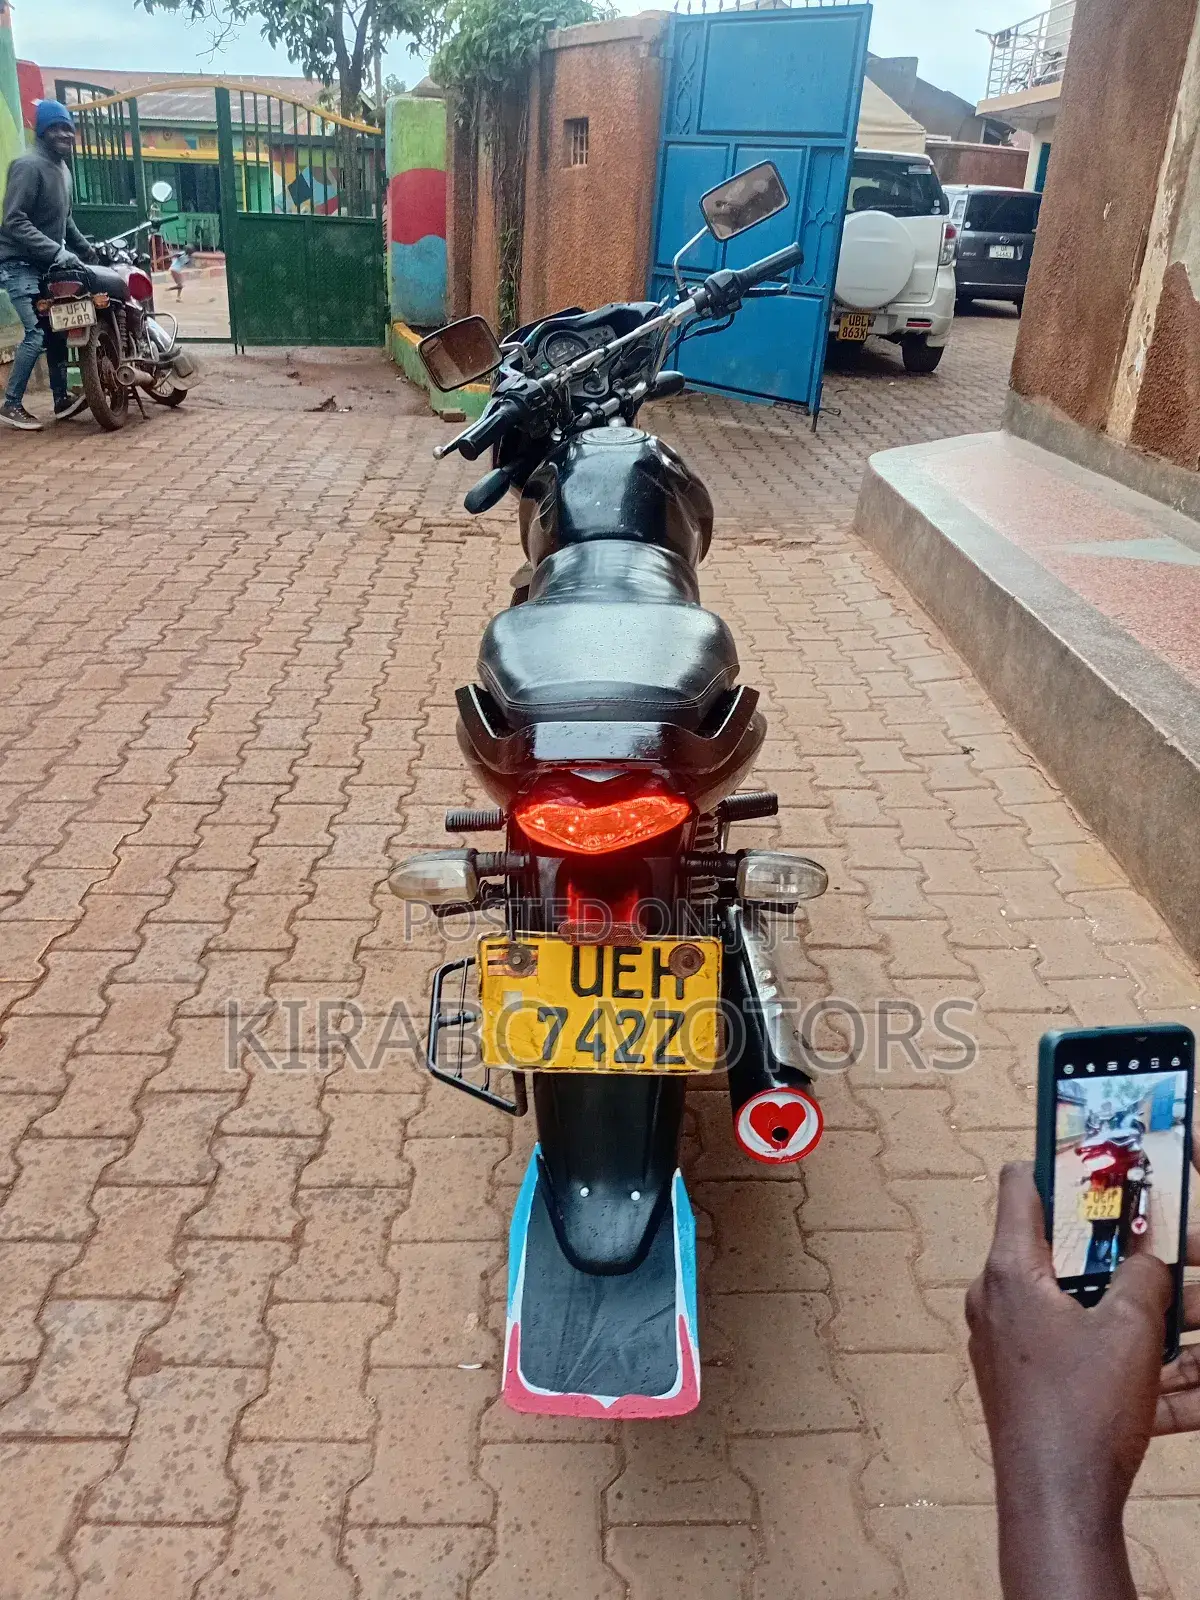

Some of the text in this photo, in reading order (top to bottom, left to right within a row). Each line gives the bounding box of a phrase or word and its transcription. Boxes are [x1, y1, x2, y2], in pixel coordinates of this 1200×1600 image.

[842, 326, 866, 339] 863X
[848, 315, 867, 327] UBL
[570, 945, 685, 1000] UEH
[537, 1006, 686, 1064] 742Z
